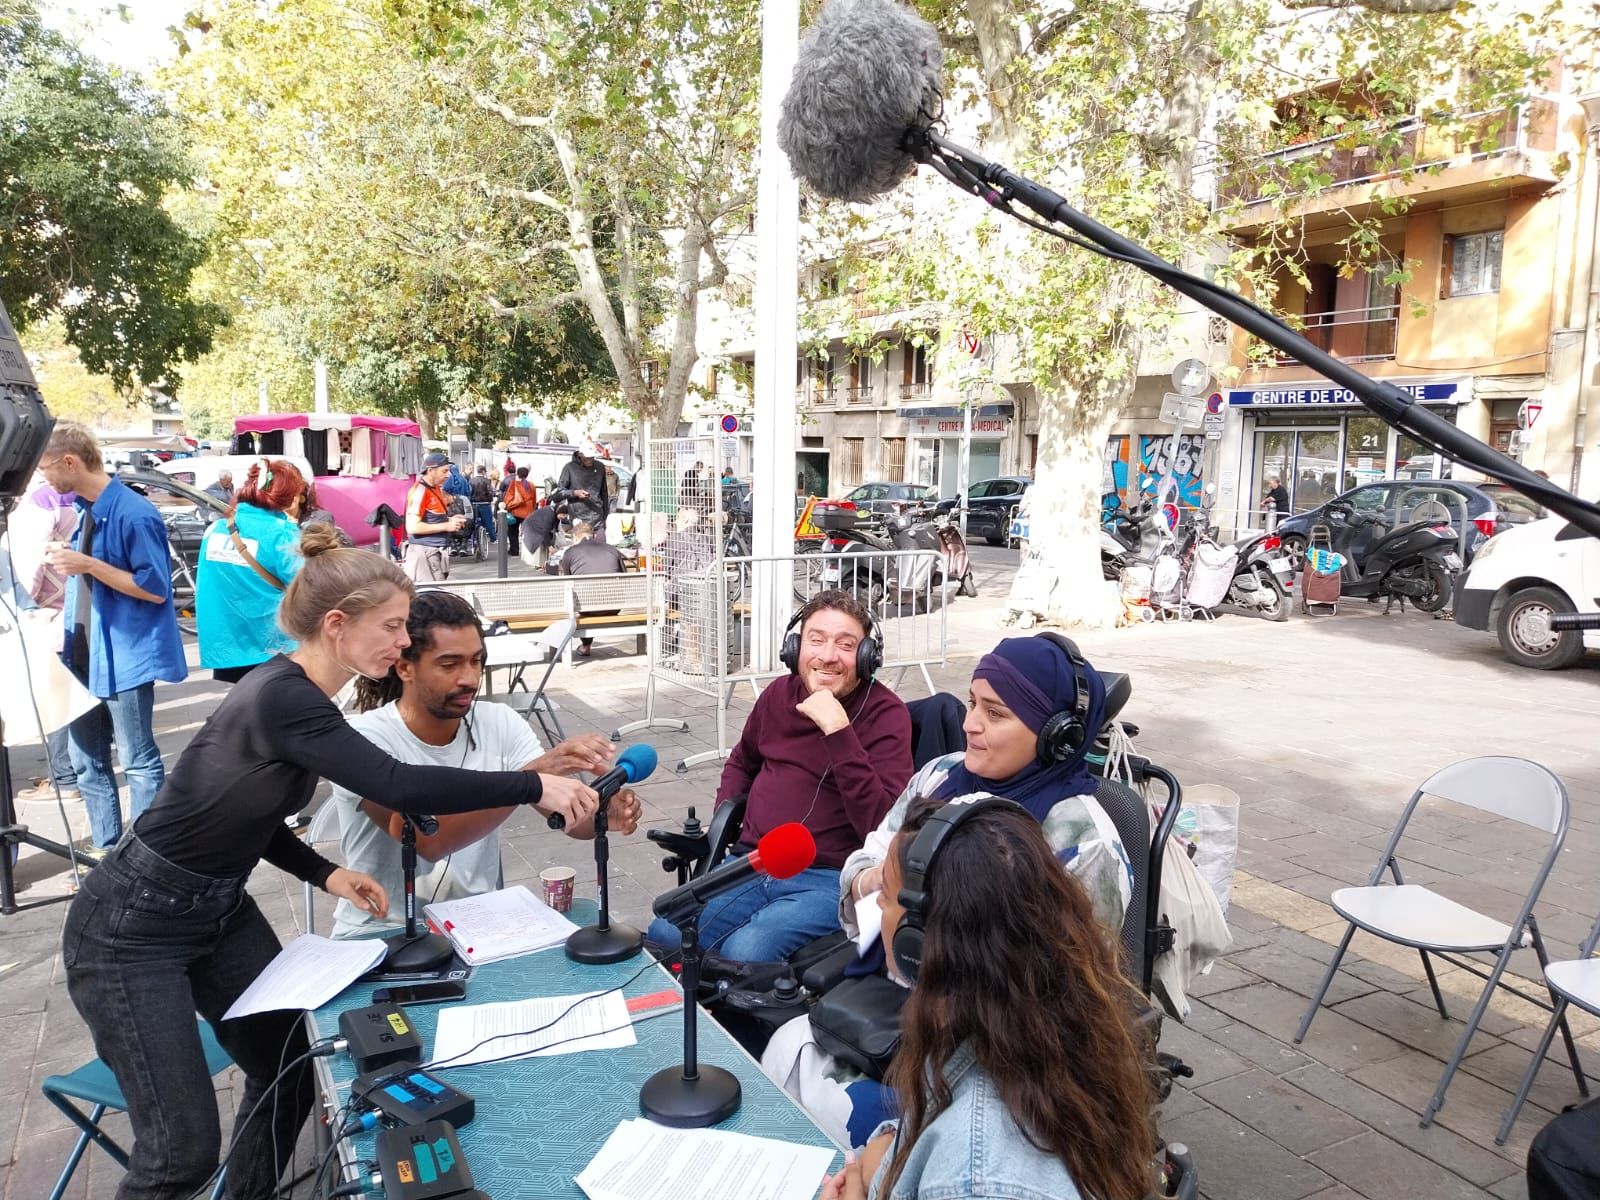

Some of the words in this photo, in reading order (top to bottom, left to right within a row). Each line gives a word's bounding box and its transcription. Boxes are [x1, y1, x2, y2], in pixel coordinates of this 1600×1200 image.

[1252, 391, 1306, 404] CENTRE
[1310, 390, 1330, 403] DE
[938, 421, 958, 432] CENTRE
[1361, 434, 1379, 447] 21
